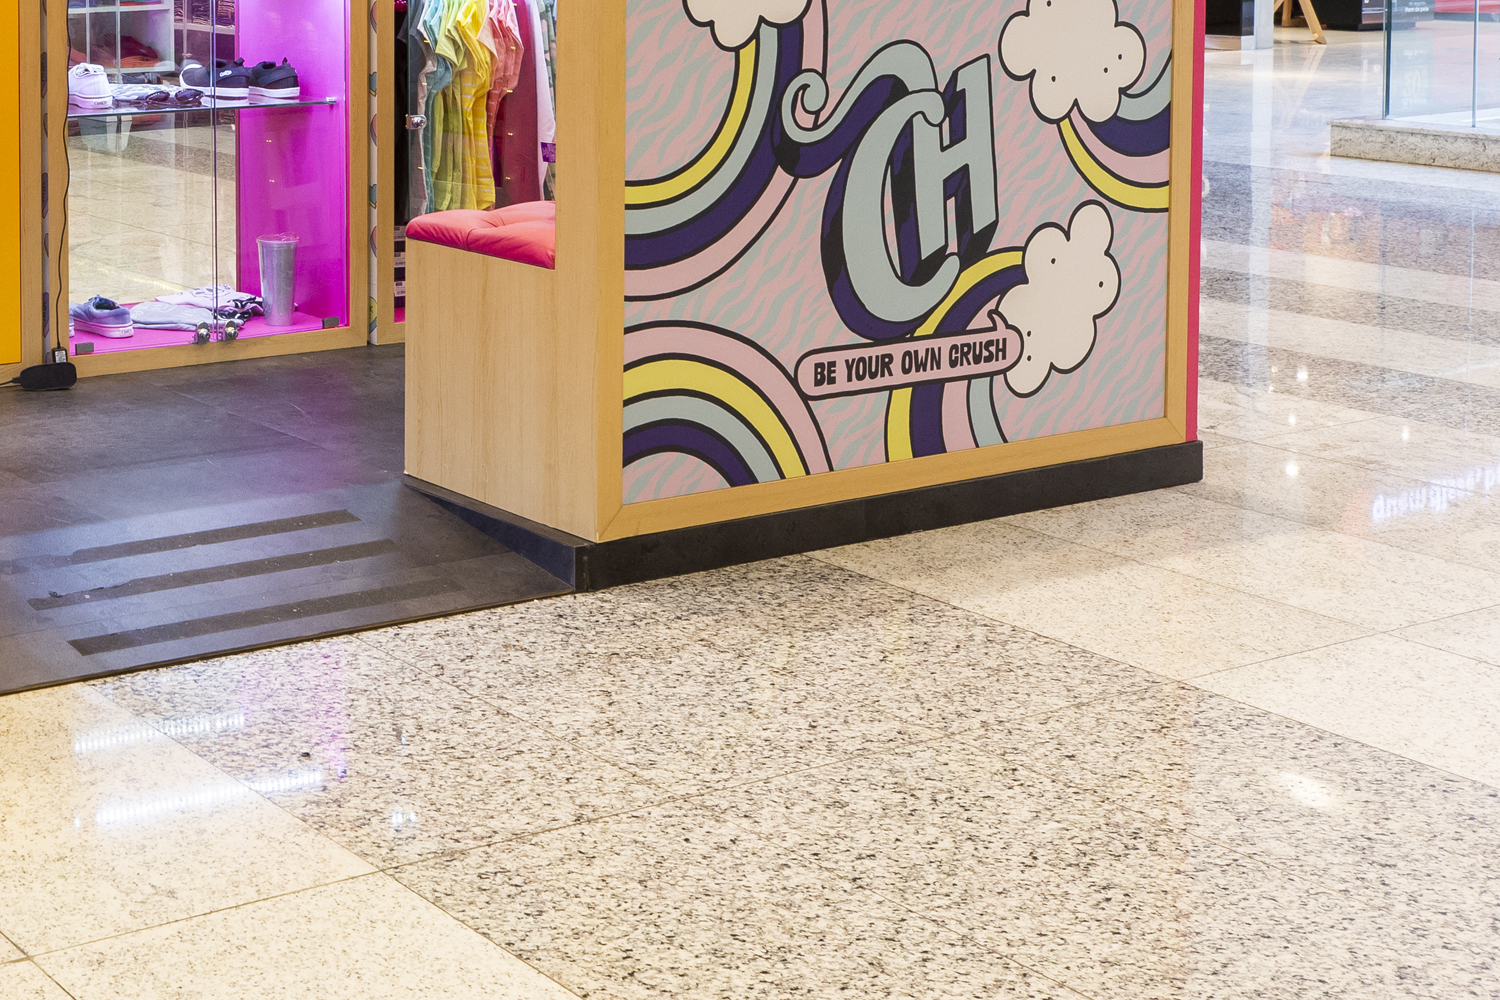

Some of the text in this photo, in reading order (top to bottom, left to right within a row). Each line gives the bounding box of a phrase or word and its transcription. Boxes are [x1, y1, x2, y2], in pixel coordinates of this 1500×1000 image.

[813, 337, 1008, 388] BE YOUR OWN CRUSH
